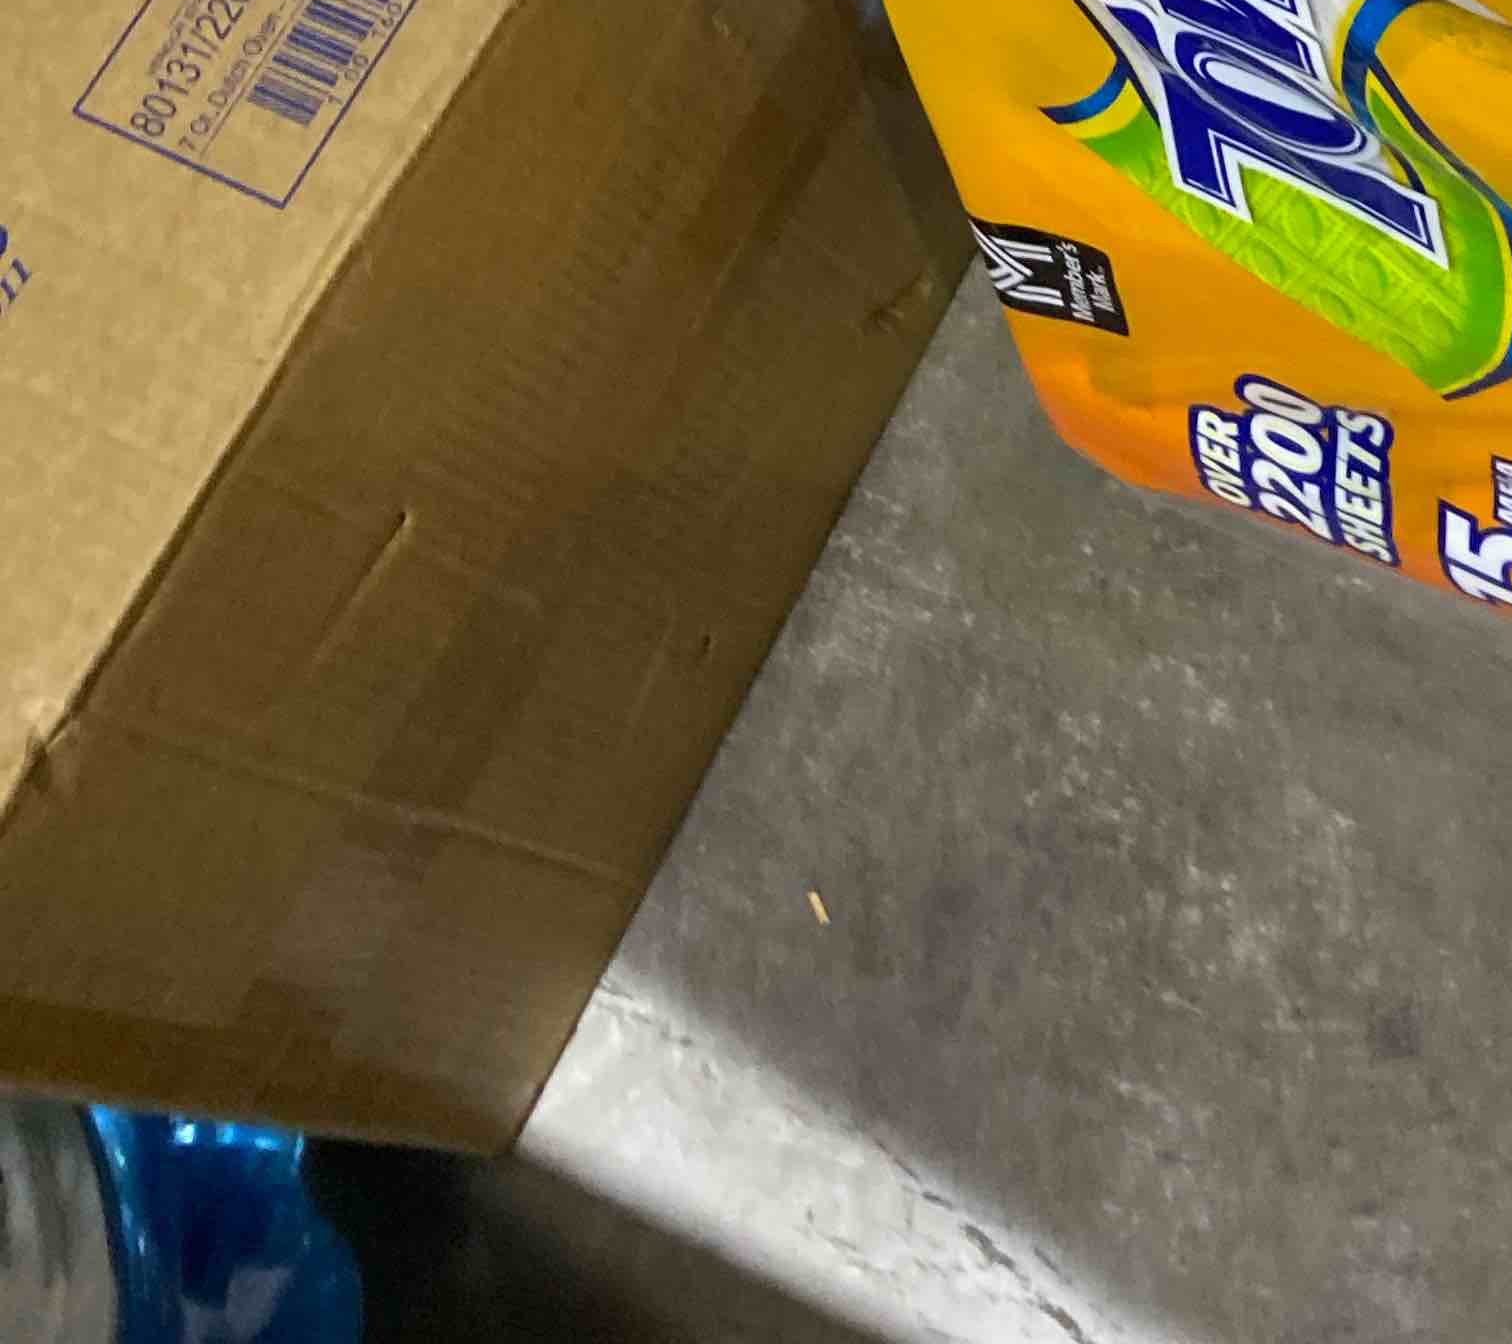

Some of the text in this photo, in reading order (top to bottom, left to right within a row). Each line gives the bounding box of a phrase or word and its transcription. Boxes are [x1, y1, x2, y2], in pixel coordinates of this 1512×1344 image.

[1055, 239, 1096, 324] Member's
[1090, 265, 1116, 313] Mark
[1194, 409, 1254, 509] OVER
[1243, 378, 1334, 545] 2200
[1333, 407, 1395, 563] SHEETS
